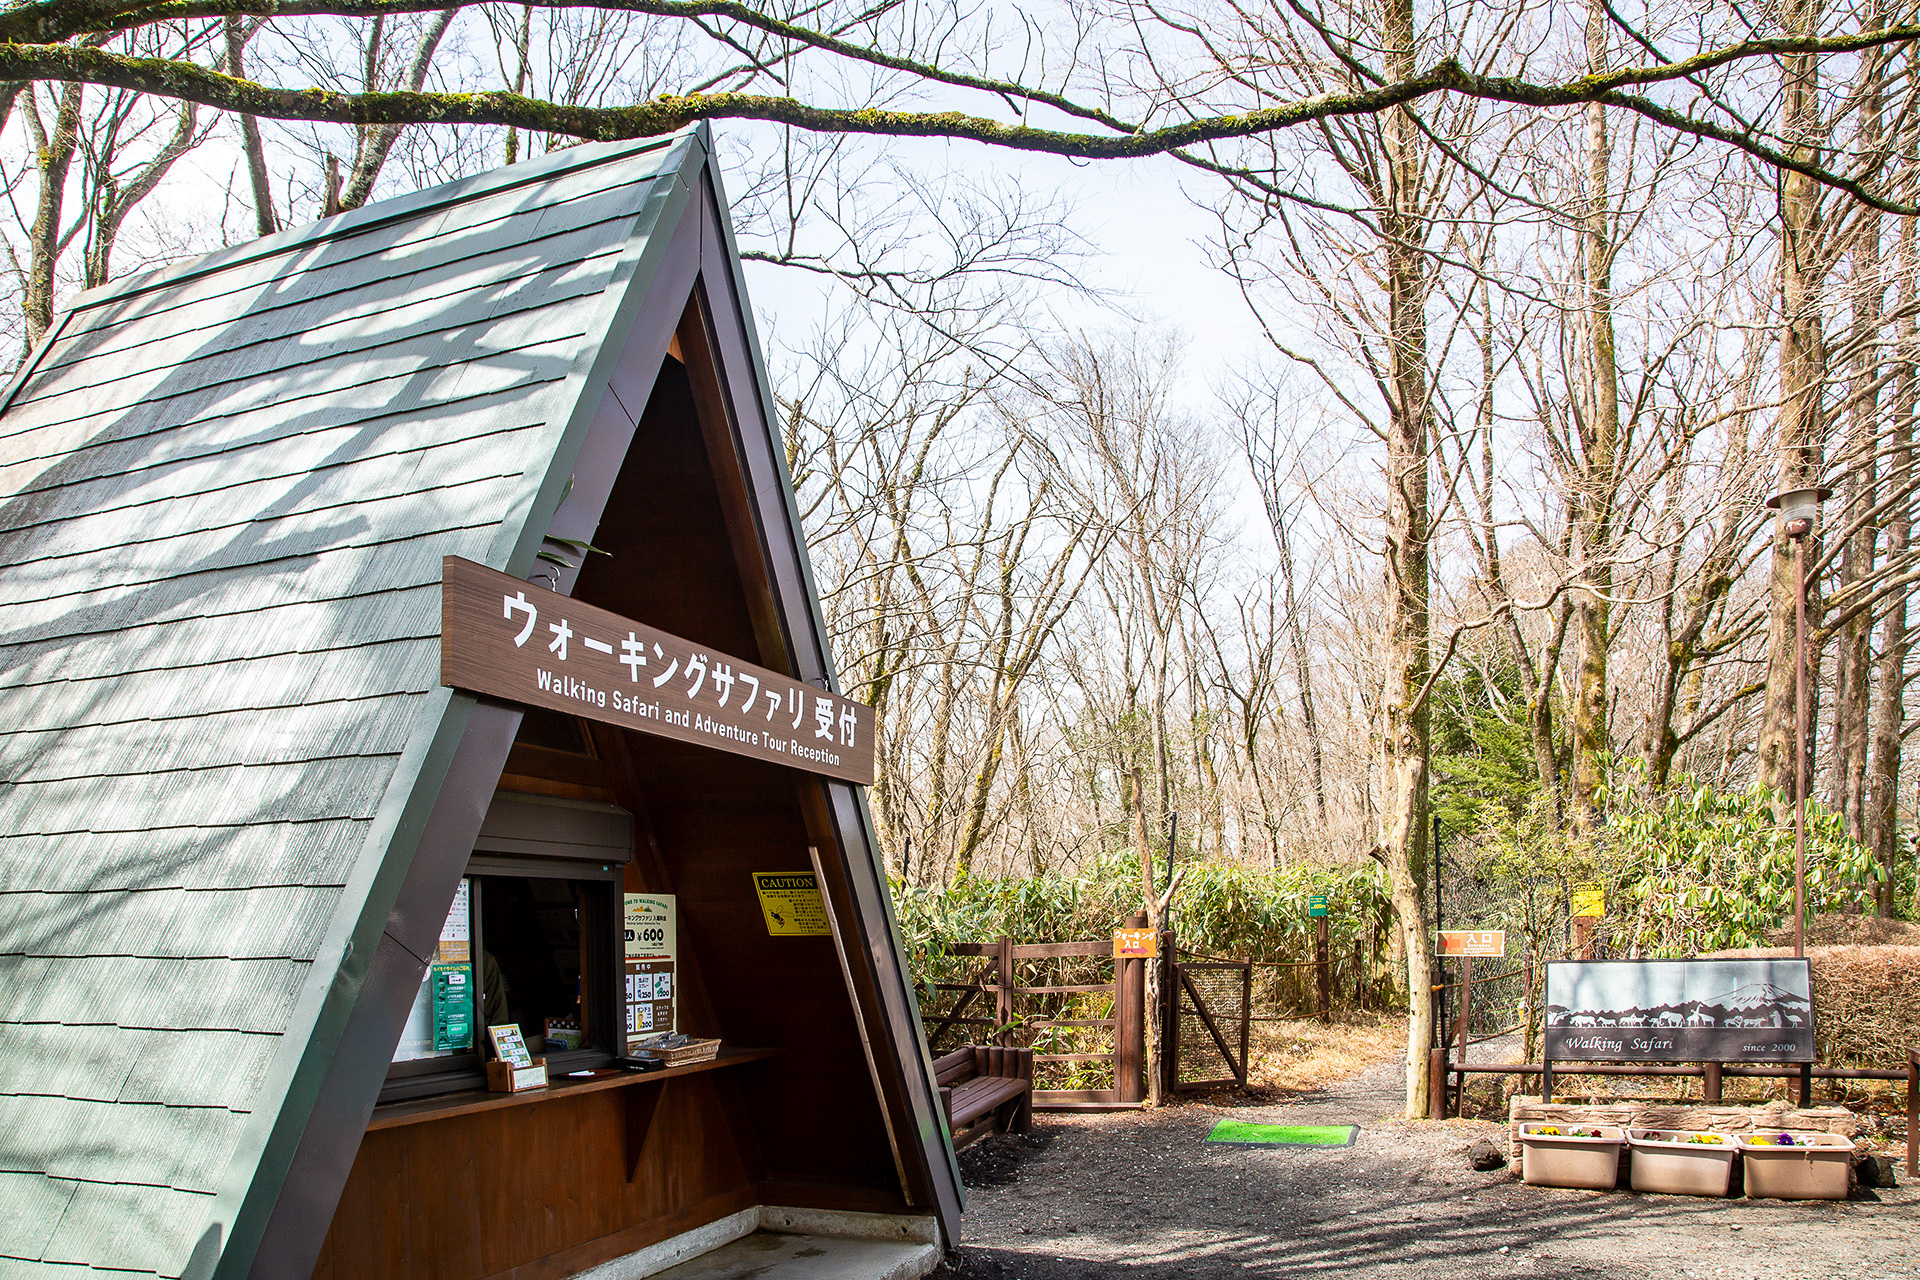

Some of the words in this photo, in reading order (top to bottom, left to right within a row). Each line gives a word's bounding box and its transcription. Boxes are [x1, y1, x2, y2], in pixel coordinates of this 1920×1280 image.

[503, 590, 804, 730] ウォーキングサファリ
[815, 696, 858, 748] 受付
[536, 668, 606, 708] Walking
[612, 690, 660, 720] Safari
[665, 709, 690, 728] and
[694, 713, 759, 745] Adventure
[762, 731, 788, 753] Tour
[790, 739, 840, 767] Reception
[761, 877, 813, 888] CAUTION
[1115, 929, 1156, 941] ウォーキング
[1466, 933, 1493, 944] 入口
[1124, 940, 1140, 949] 入口
[1565, 1036, 1623, 1052] Walking
[1630, 1037, 1674, 1053] Safari
[1742, 1043, 1766, 1052] since
[1771, 1043, 1796, 1052] 2000
